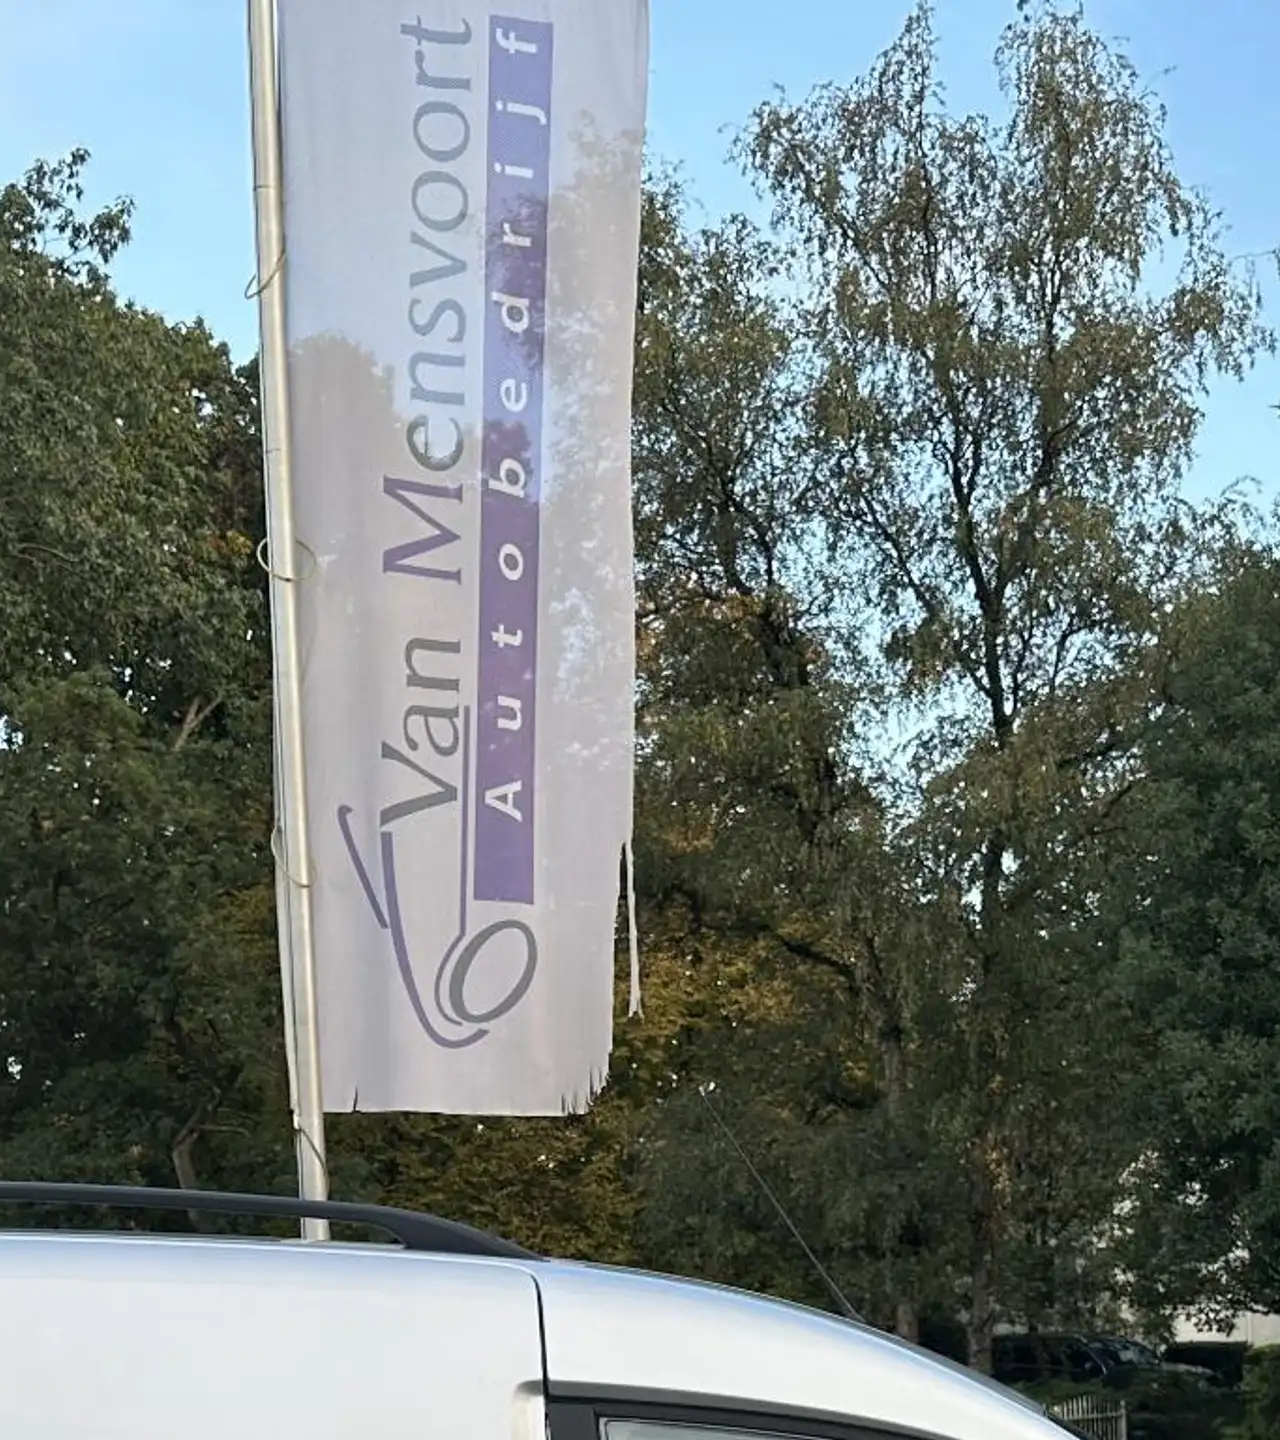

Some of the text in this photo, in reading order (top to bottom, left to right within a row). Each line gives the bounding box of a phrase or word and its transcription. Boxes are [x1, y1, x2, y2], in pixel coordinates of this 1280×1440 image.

[380, 13, 472, 831] Van Mensvoort
[485, 27, 547, 822] Autobedrijf
